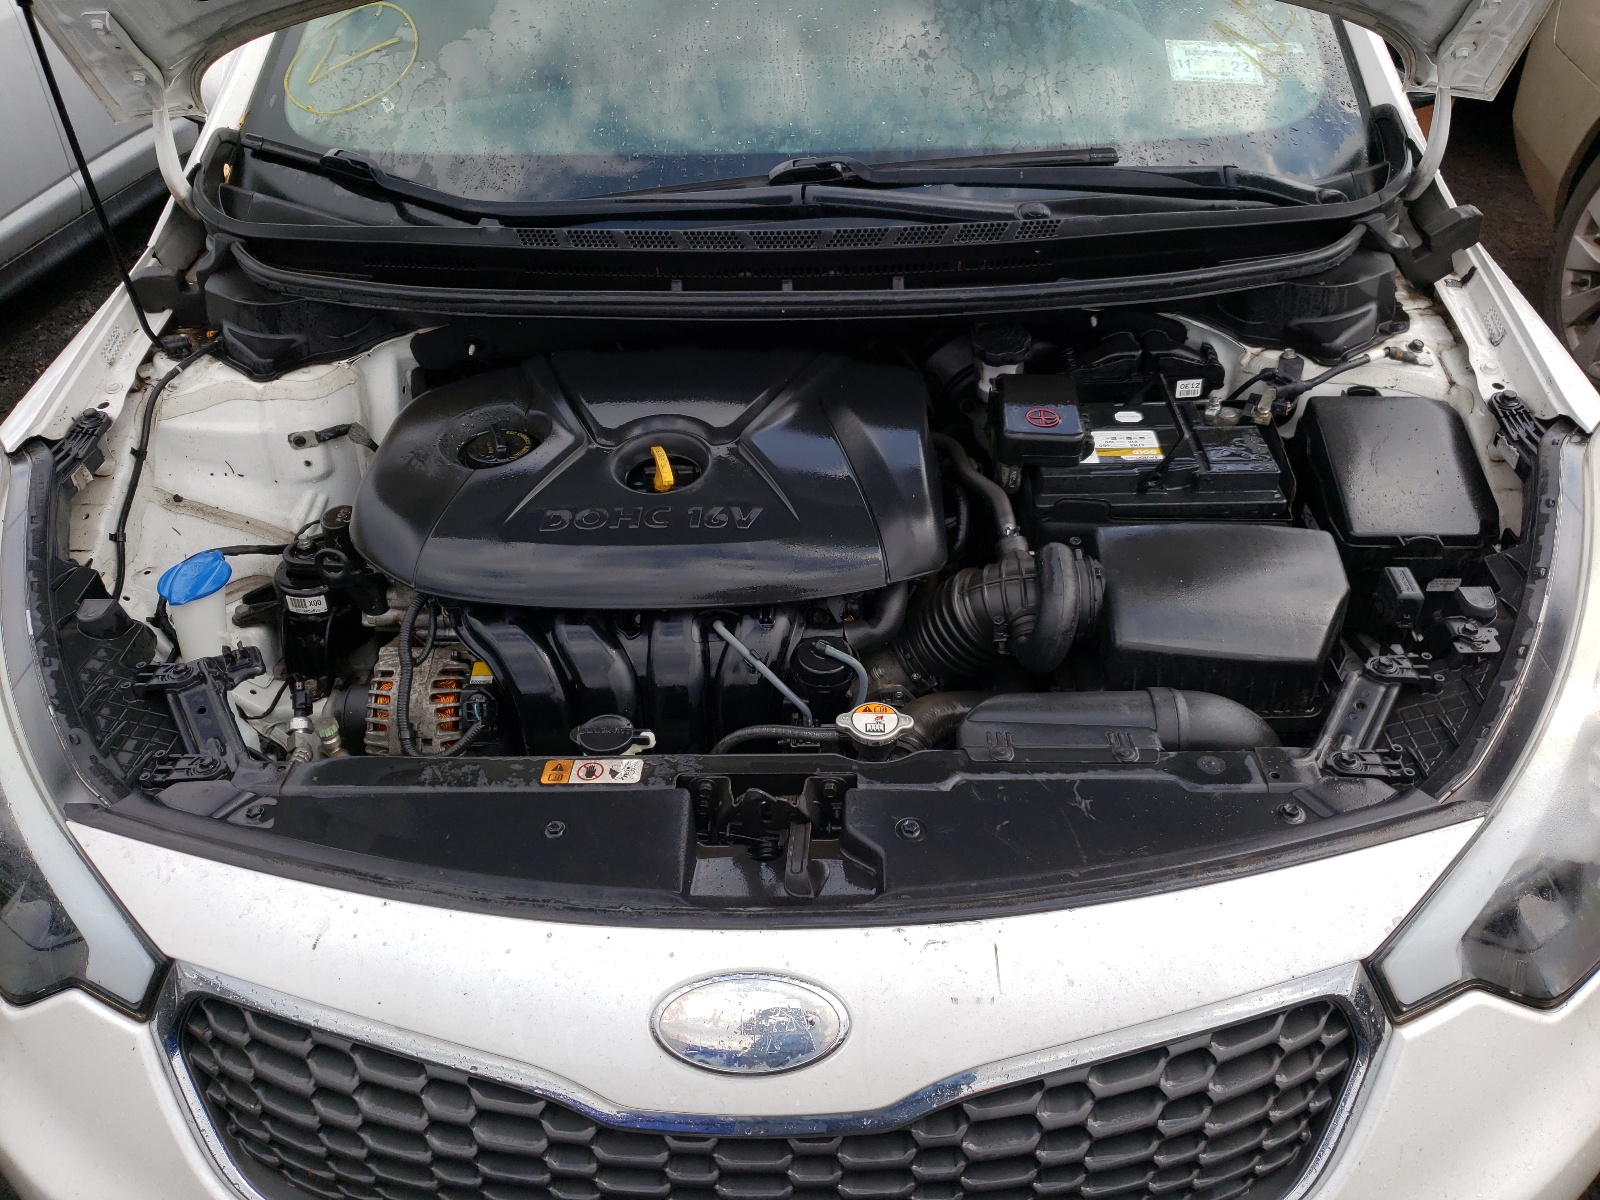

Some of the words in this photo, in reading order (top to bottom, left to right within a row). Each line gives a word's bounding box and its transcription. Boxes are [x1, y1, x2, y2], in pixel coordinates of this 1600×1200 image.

[1177, 58, 1191, 70] 11
[1231, 60, 1251, 73] 22
[539, 506, 672, 532] DOHC
[687, 506, 765, 529] 16V
